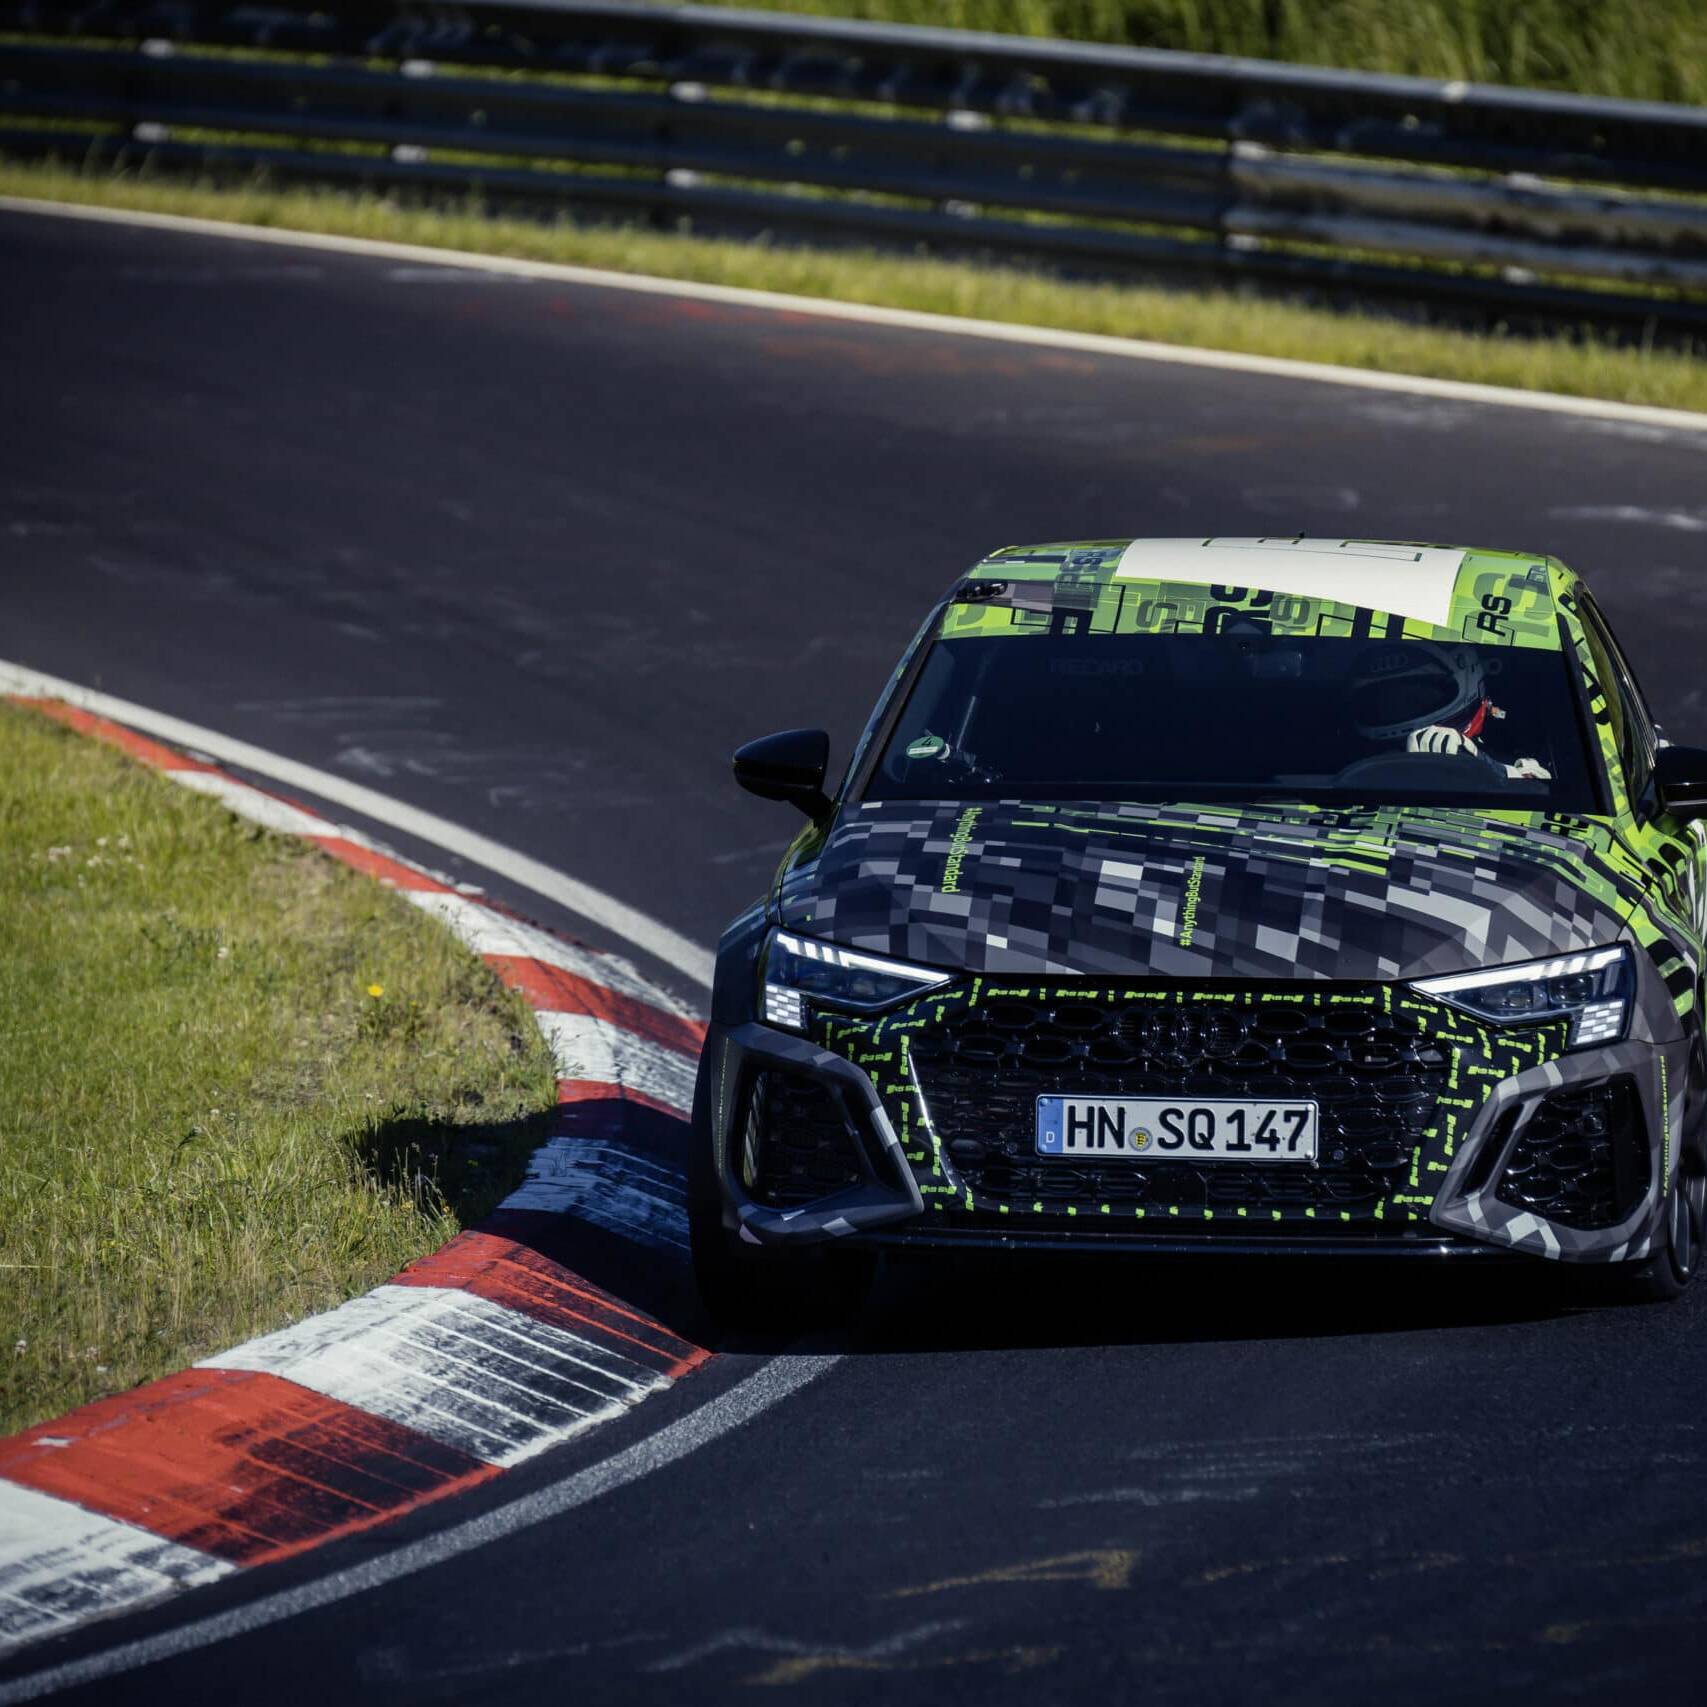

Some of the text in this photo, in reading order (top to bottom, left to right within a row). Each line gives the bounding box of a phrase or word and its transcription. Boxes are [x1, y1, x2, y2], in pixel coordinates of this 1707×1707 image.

[1477, 594, 1512, 637] RS
[1179, 856, 1205, 947] #AnythingButStandard
[1046, 1131, 1055, 1143] D
[1067, 1105, 1310, 1152] HN SQ 147
